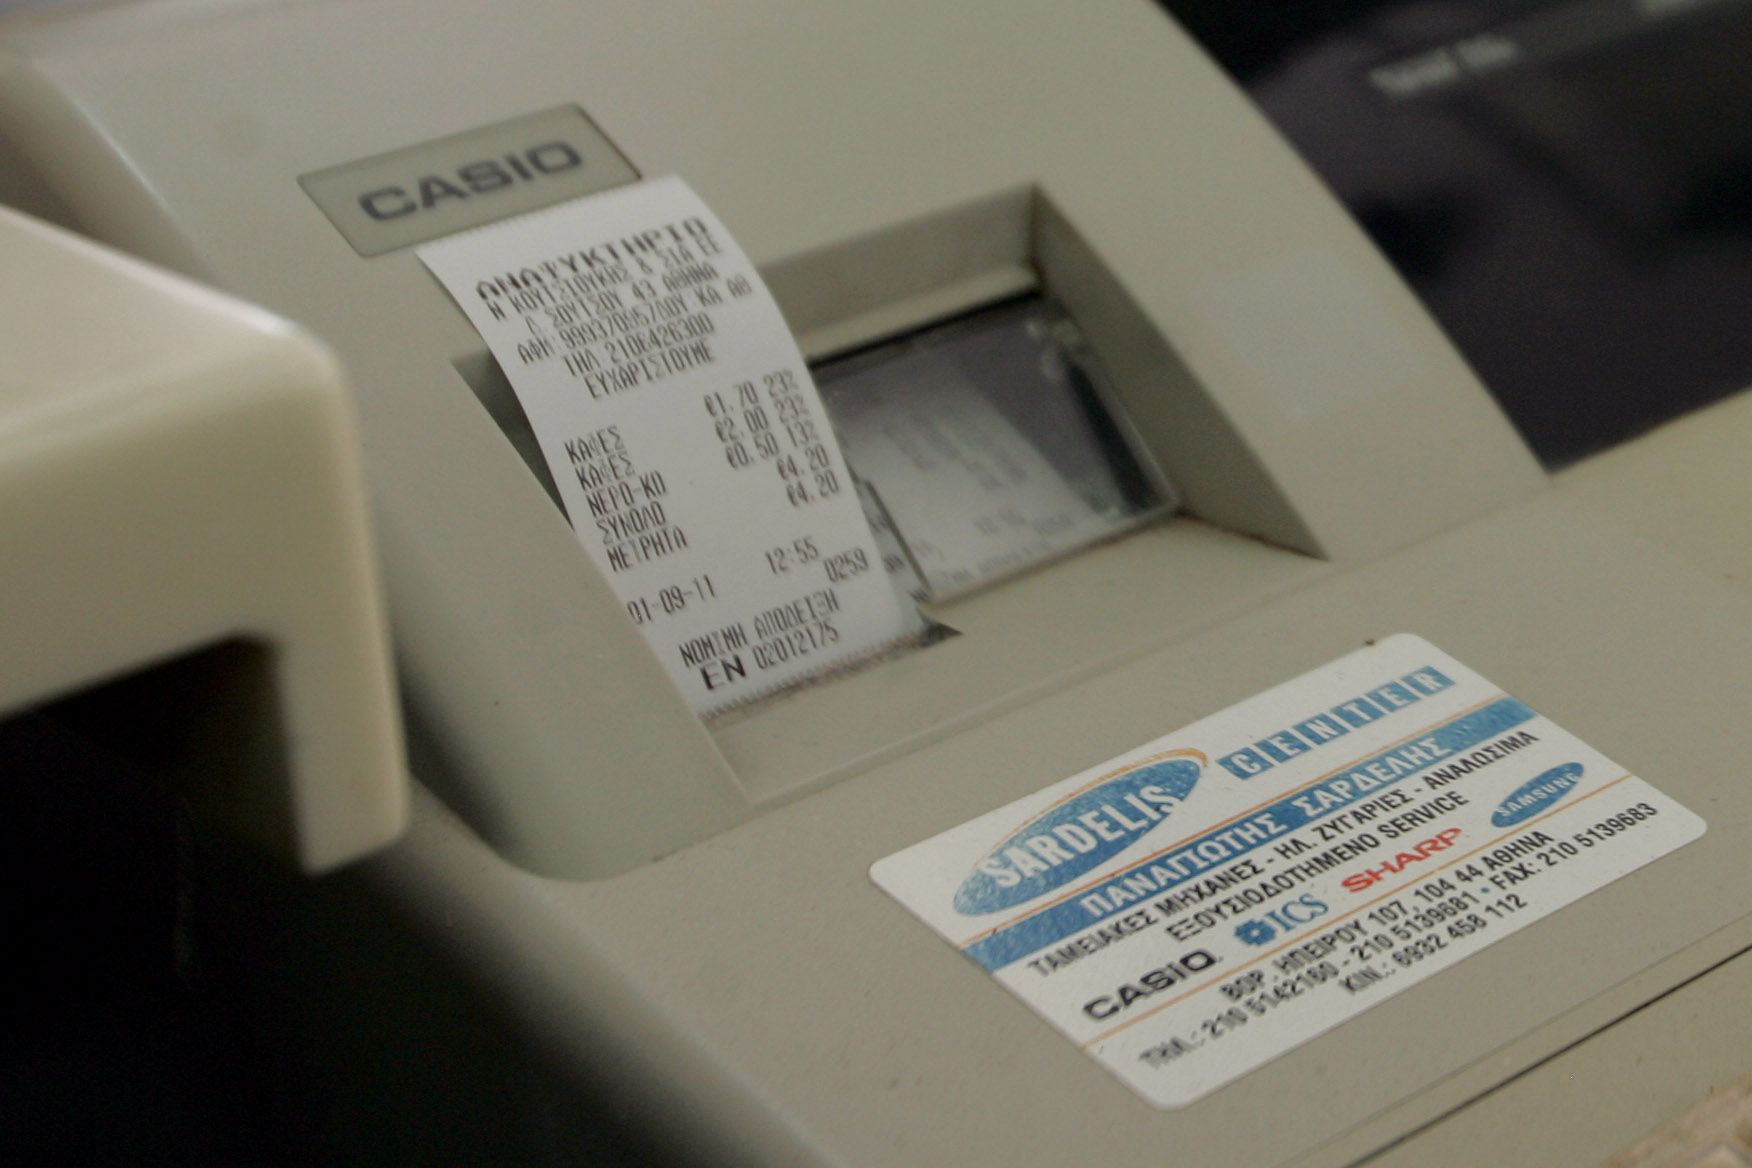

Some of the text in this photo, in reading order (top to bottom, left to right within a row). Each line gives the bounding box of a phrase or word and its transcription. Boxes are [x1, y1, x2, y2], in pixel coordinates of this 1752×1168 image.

[357, 140, 583, 222] CASIO
[476, 217, 708, 301] ΑΝΑΨΥΚΤΗΡΙΟ
[655, 241, 694, 270] ΣΙΑ
[543, 288, 624, 330] ΣΟΥΤΣΟΥ
[630, 280, 656, 303] 43
[660, 261, 720, 295] ΑΘΗΝΑ
[563, 311, 716, 378] ΤΗΛ 2106426300
[583, 337, 716, 400] ΕΥΧΑΡΙΣΤΟΥΜΕ
[763, 368, 798, 398] 23%
[563, 424, 625, 465] ΚΑΦΕΣ
[773, 393, 810, 423] 23%
[574, 450, 637, 493] ΚΑΦΕΣ
[585, 469, 669, 519] ΝΕΡΟ-ΚΟ
[595, 500, 668, 546] ΣΥΝΟΛΟ
[606, 524, 689, 573] ΜΕΤΡΗΤΑ
[626, 535, 821, 626] 01-09-11 12:55
[822, 546, 870, 583] 0259
[678, 587, 841, 669] ΝΟΜΙΜΗ ΑΠΟΔΕΙΞΗ
[751, 620, 841, 671] 02012175
[977, 670, 1448, 888] SARDELIS CENTER
[1497, 772, 1579, 817] SAMSUNG
[1026, 909, 1160, 978] ΤΑΜΕΙΑΚΕΣ
[1152, 858, 1267, 918] ΜΗΧΑΝΕΣ
[1271, 833, 1319, 860] ΗΛ.
[1310, 788, 1415, 841] ΖΥΓΑΡΙΕΣ
[1418, 729, 1539, 790] ΑΝΑΛΩΣΙΜΑ
[1076, 736, 1452, 918] ΠΑΝΑΓΙΩΤΗΣ ΣΑΡΔΕΛΗΣ
[1341, 827, 1463, 893] SHARP
[1488, 800, 1660, 891] FAX: 210 5139683
[1162, 789, 1470, 943] ΕΞΟΥΣΙΟΔΟΤΗΜΕΝΟ SERVICE
[1266, 892, 1330, 932] ICS
[1270, 920, 1373, 976] ΗΠΕΙΡΟΥ
[1411, 877, 1459, 904] 104
[1449, 862, 1487, 885] 44
[1477, 829, 1554, 871] ΑΘΗΝΑ
[1388, 932, 1450, 968] 6932
[1440, 912, 1489, 941] 458
[1483, 891, 1529, 918] 112
[1082, 948, 1218, 1020] CASIO
[1198, 1006, 1254, 1039] 210
[1347, 933, 1397, 963] 210
[1388, 890, 1482, 942] 5139681
